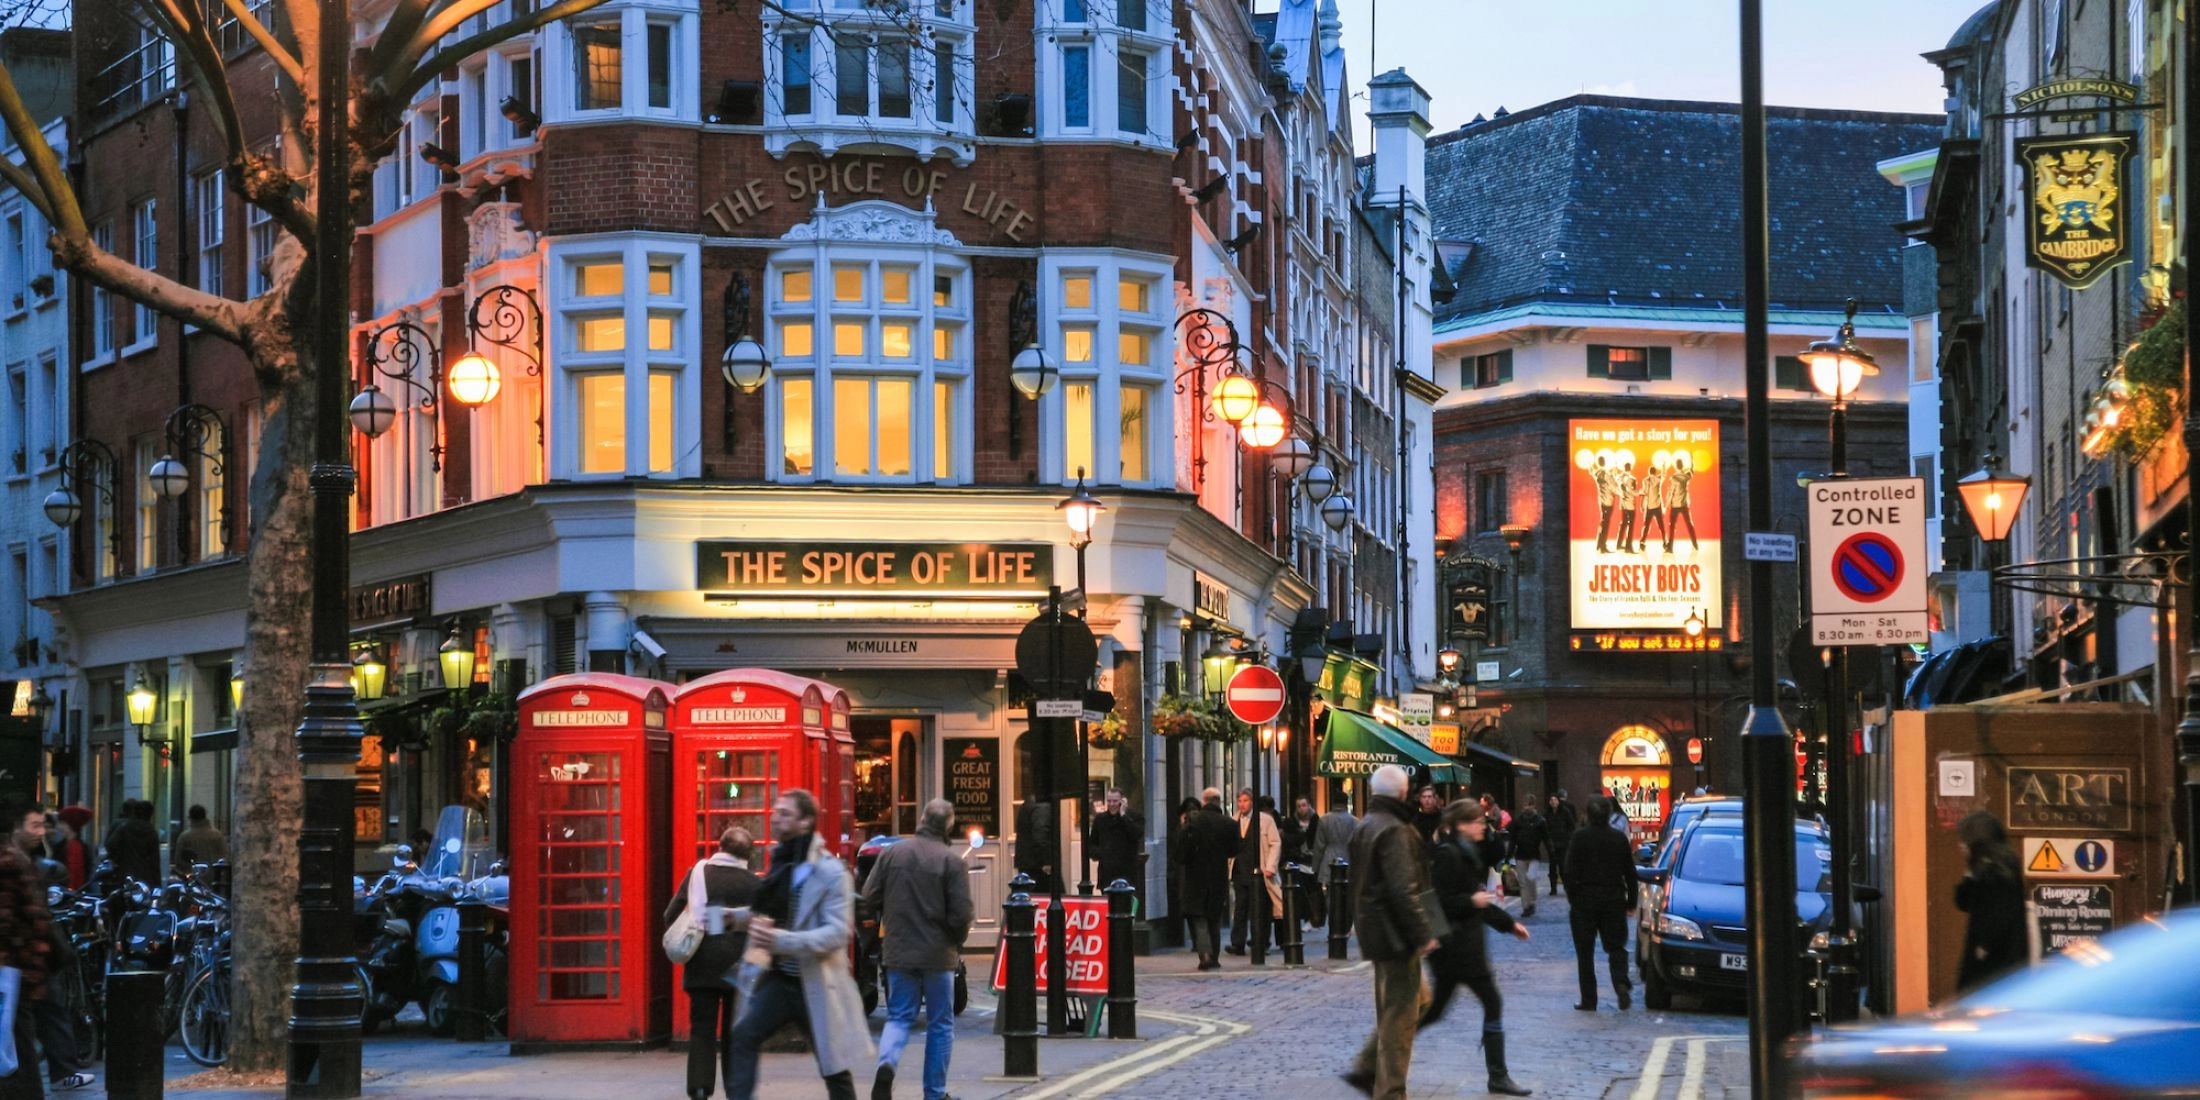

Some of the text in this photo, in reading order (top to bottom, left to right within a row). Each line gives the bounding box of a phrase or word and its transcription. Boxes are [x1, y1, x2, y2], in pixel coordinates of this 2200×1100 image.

[2018, 80, 2135, 105] NICHOLSON'S
[703, 161, 1035, 242] THE SPICE OF LIFE
[2064, 230, 2089, 239] THE
[2040, 239, 2116, 259] CAMBRIDGE
[1575, 427, 1712, 443] Have we got a story for you!
[1816, 486, 1916, 503] Controlled
[1831, 507, 1901, 526] ZONE
[1749, 537, 1793, 548] No loading
[1759, 550, 1773, 558] any
[1776, 549, 1793, 557] time
[721, 551, 1036, 585] THE SPICE OF LIFE
[1589, 564, 1700, 593] JERSEY BOYS
[1842, 618, 1866, 627] Mon
[1878, 618, 1897, 626] Sat
[1818, 631, 1845, 640] 8.30
[1876, 630, 1903, 638] 6.30
[1905, 631, 1922, 640] pm
[846, 641, 918, 653] McMULLEN
[539, 712, 624, 725] TELEPHONE
[696, 709, 782, 722] TELEPHONE
[1333, 750, 1398, 763] RISTORANTE
[952, 762, 991, 775] GREAT
[953, 777, 990, 789] FRESH
[2015, 773, 2123, 807] ART
[955, 792, 988, 804] FOOD
[2026, 812, 2107, 822] LONDON
[2042, 886, 2090, 905] Hungry
[1034, 909, 1100, 930] RAD
[2038, 905, 2111, 921] Dining Room
